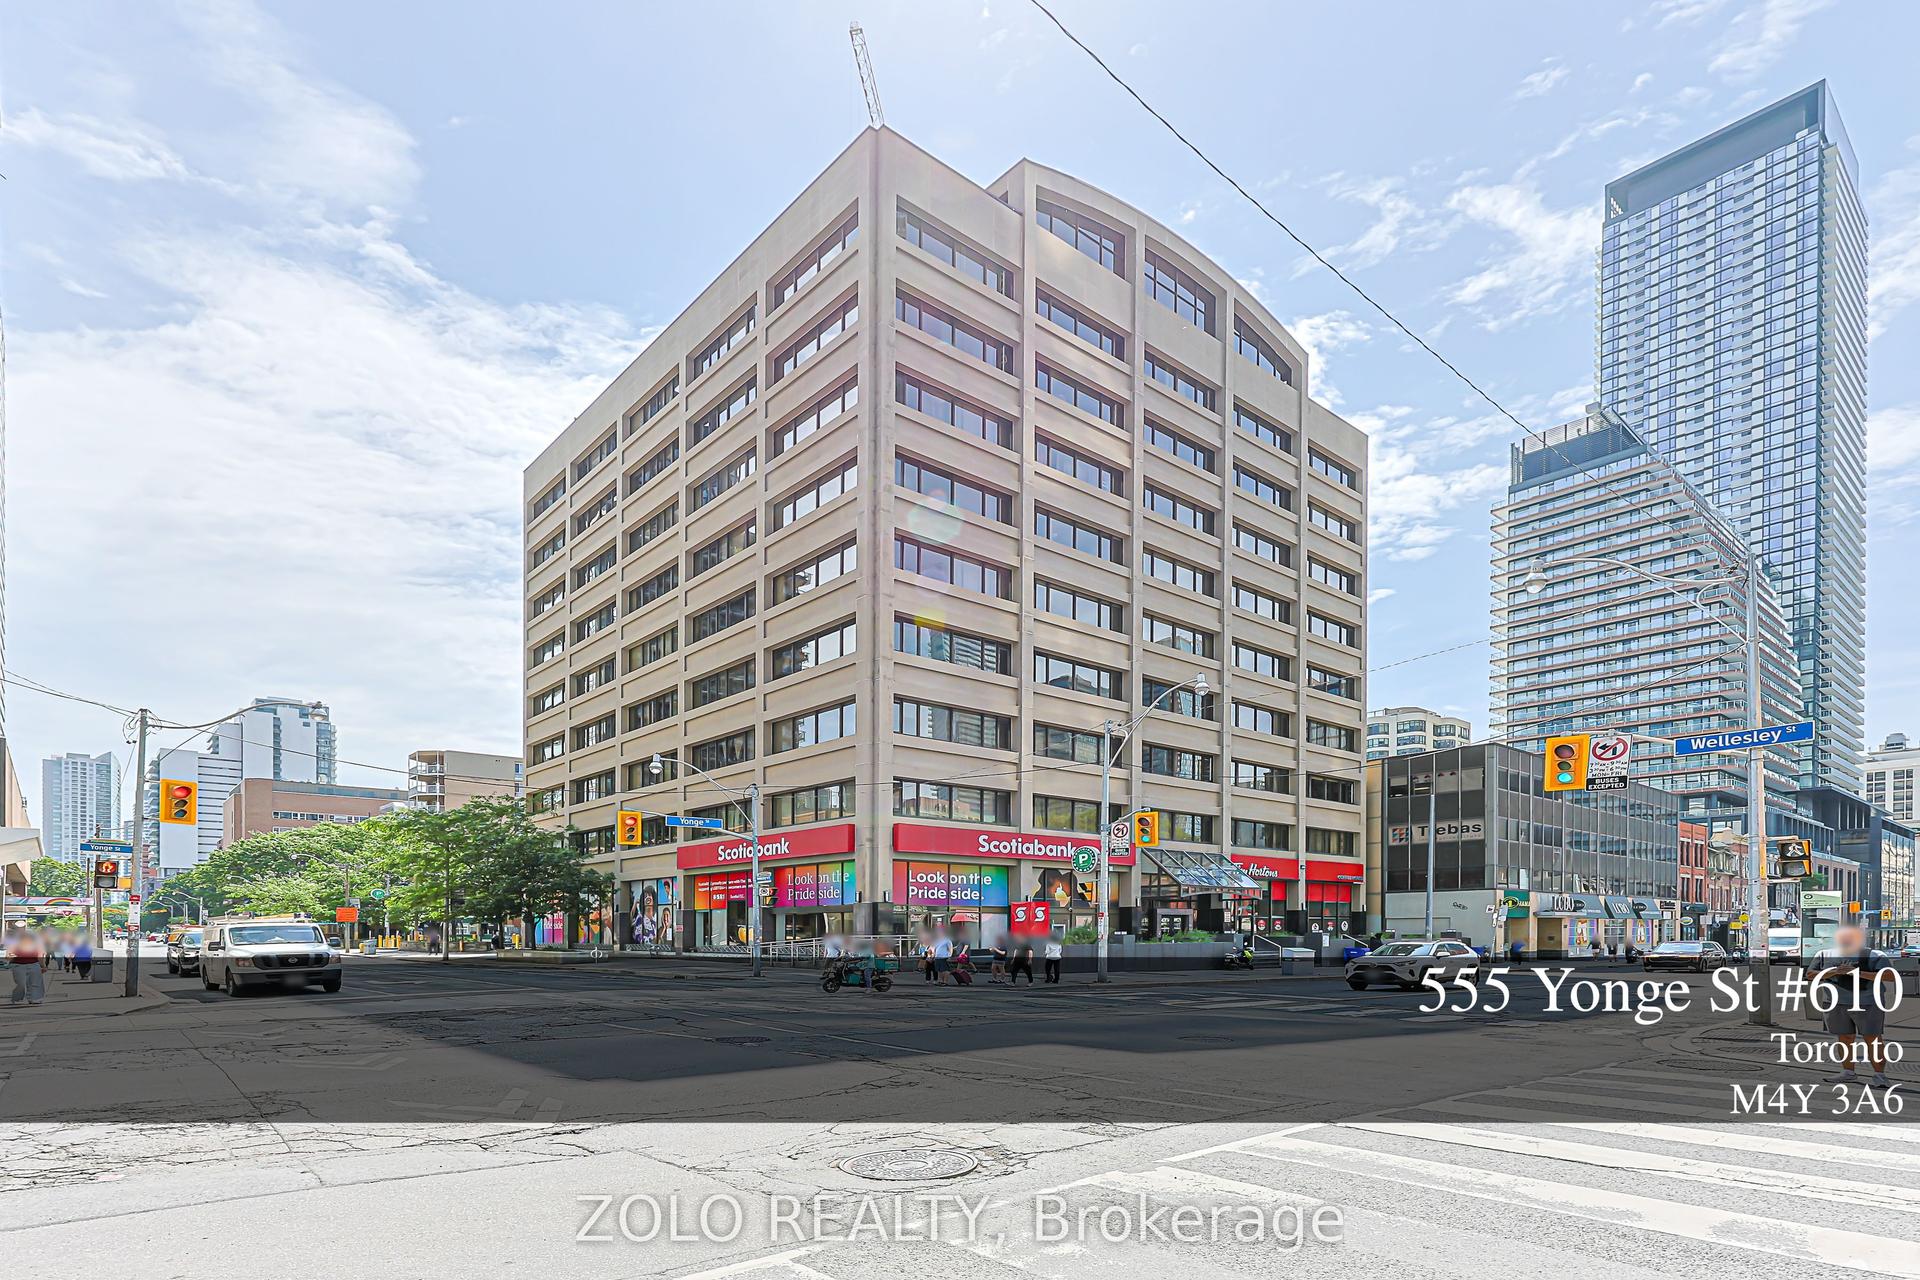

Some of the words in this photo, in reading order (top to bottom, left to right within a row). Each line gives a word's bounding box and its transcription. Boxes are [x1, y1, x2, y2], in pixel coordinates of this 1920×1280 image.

[1690, 729, 1782, 750] Wellesley
[1785, 725, 1797, 734] St
[1588, 782, 1625, 790] EXCEPTED
[679, 817, 704, 827] Yonge
[1417, 823, 1482, 837] Tebas
[90, 844, 114, 852] Yonge
[717, 837, 790, 862] Scotiabank
[977, 834, 1077, 858] Scotiabank
[908, 869, 946, 884] Look
[949, 873, 966, 884] on
[968, 872, 992, 885] the
[1248, 862, 1278, 878] Hortons
[787, 872, 814, 886] Look
[787, 886, 815, 901] Pride
[908, 885, 947, 900] Pride
[950, 887, 985, 900] side.
